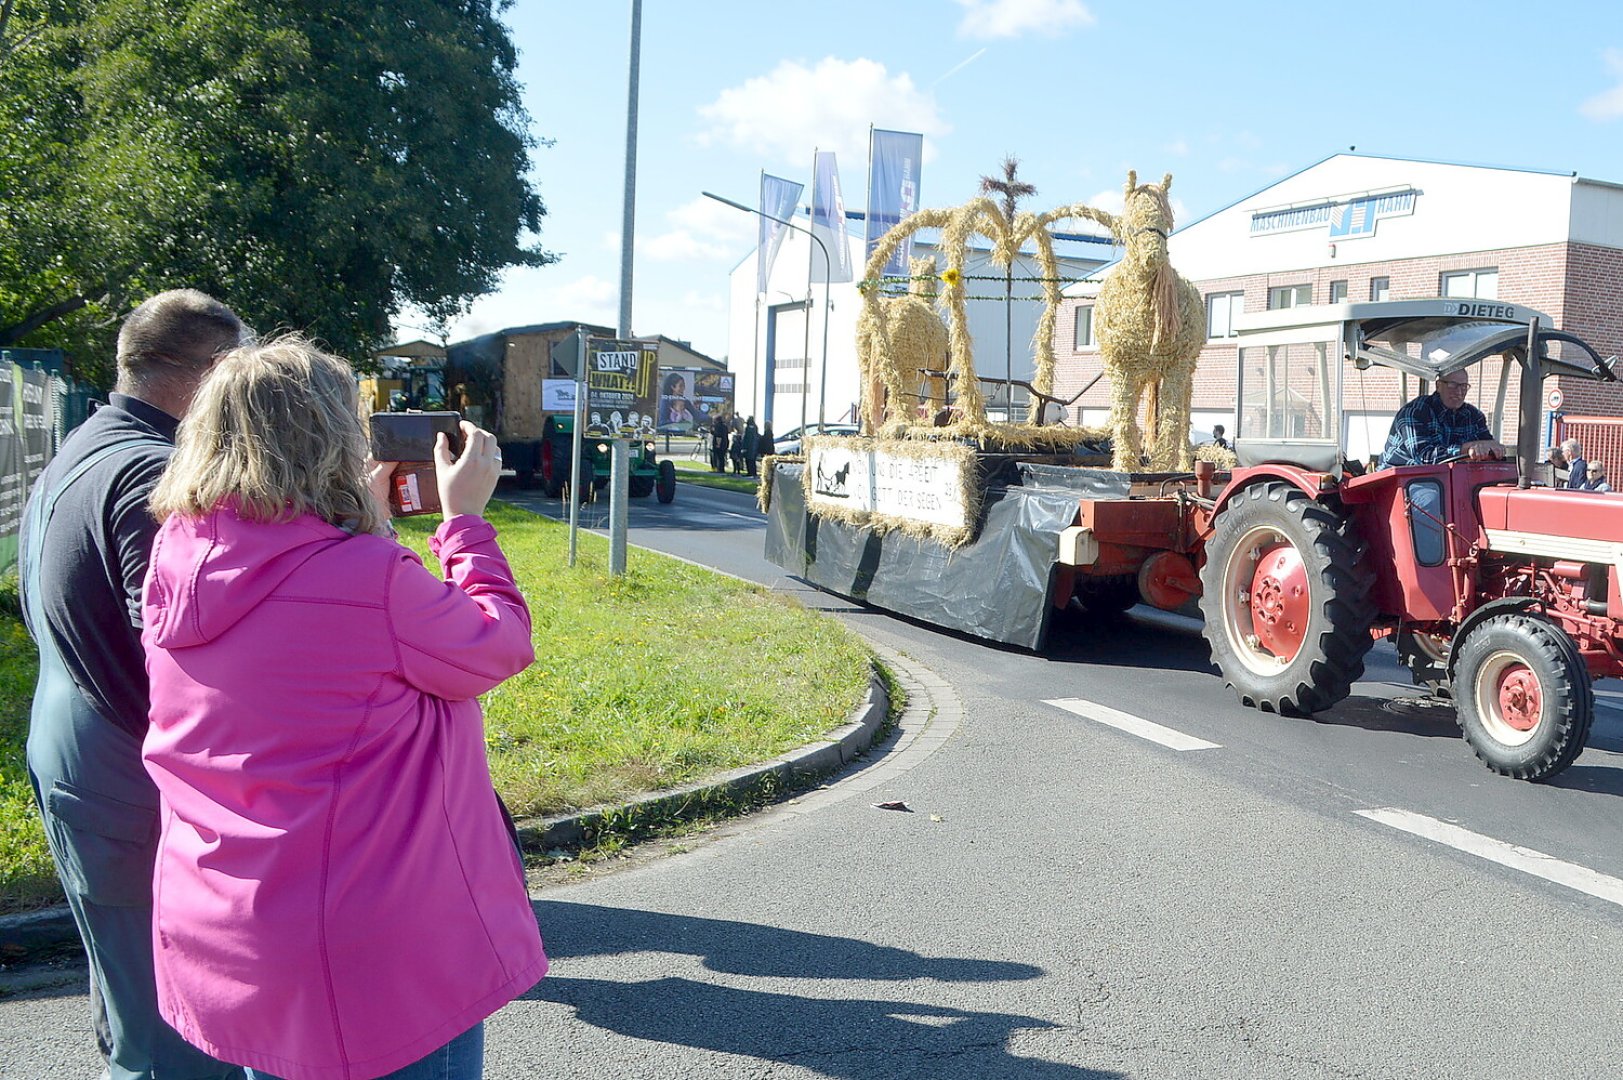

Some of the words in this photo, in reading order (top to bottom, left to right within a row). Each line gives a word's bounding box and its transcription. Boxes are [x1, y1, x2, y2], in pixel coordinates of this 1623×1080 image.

[1250, 206, 1331, 233] MASCHINENBAU
[1377, 193, 1413, 214] HAHN
[1458, 303, 1515, 319] DIETEG
[599, 353, 637, 369] STAND
[635, 350, 656, 398] UP
[889, 463, 903, 480] DIE
[897, 489, 913, 507] DER
[917, 491, 942, 511] SEGEN
